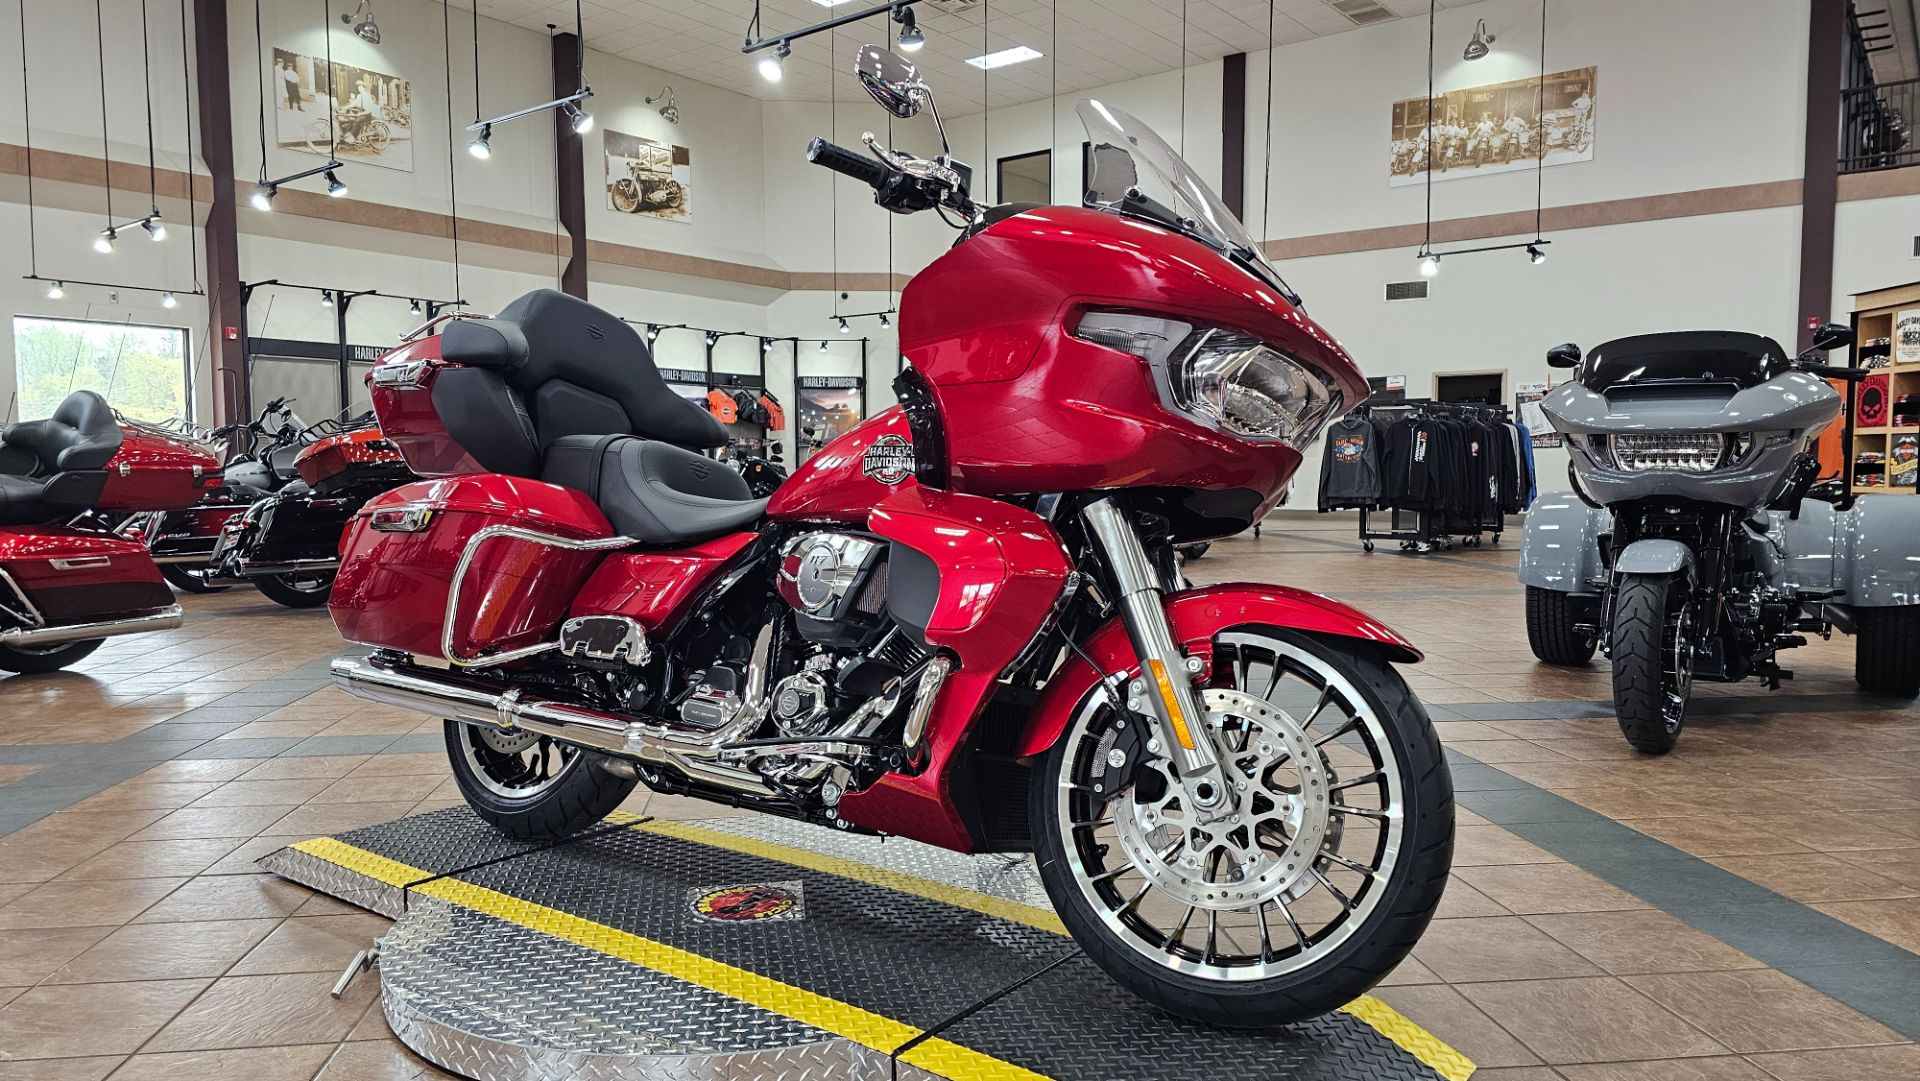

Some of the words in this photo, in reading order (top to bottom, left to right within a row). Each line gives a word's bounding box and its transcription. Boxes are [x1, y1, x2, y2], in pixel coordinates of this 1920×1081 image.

[354, 346, 384, 360] HARLEY
[803, 377, 857, 388] HARLEY-DAVIDSON
[864, 456, 916, 473] DAVIDSON
[810, 555, 828, 565] 117
